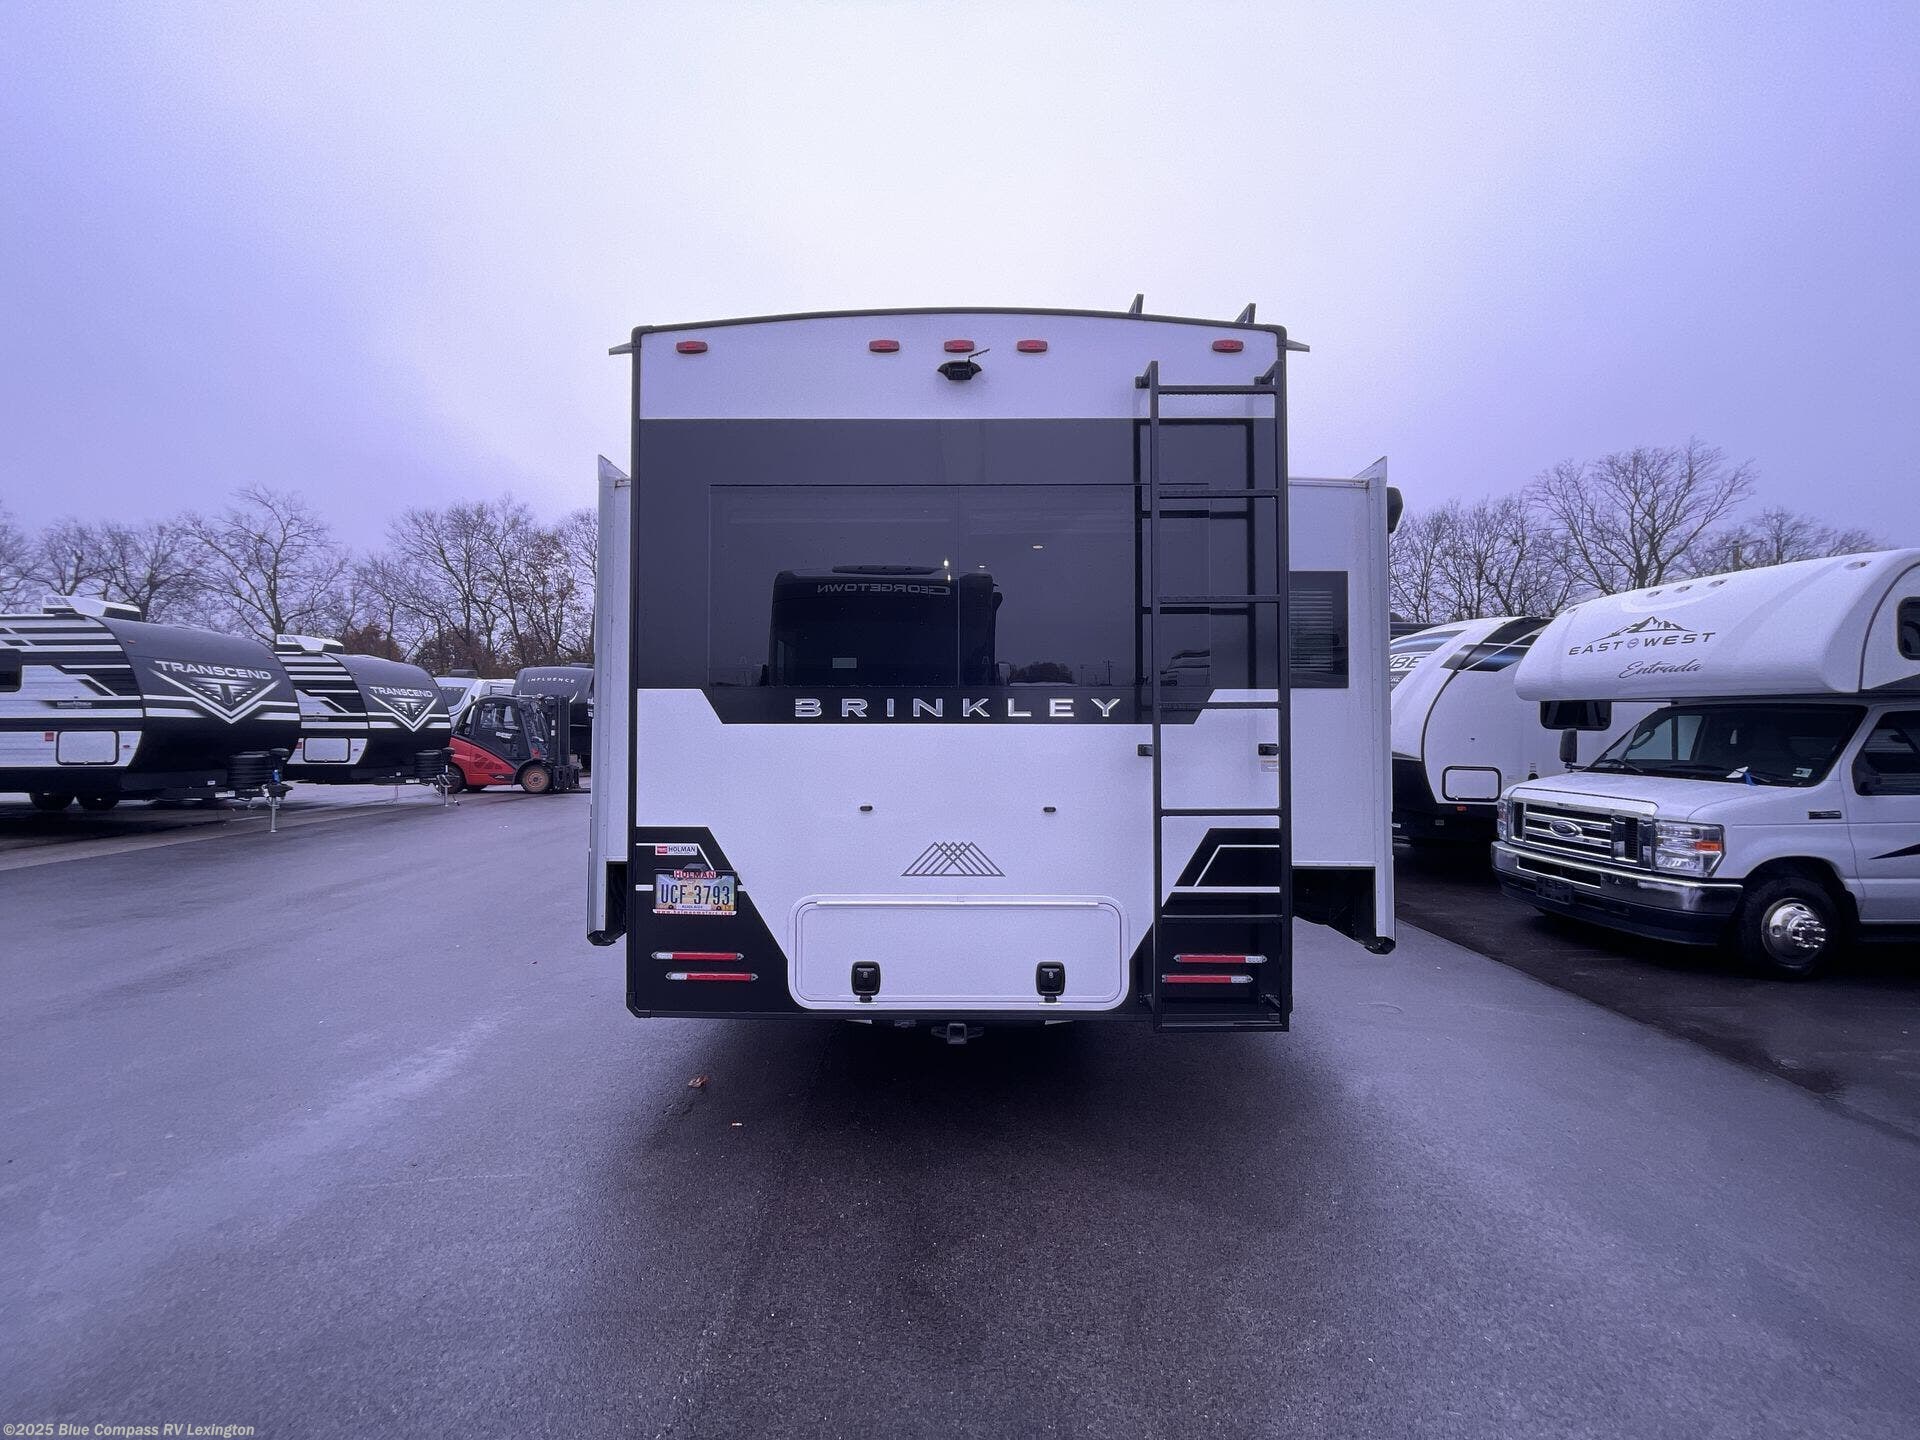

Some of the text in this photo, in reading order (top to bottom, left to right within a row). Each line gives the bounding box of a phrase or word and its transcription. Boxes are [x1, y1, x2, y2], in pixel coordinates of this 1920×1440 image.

[1568, 641, 1624, 656] EAST
[1643, 632, 1716, 647] WEST
[154, 660, 273, 680] TRANSCEND
[1618, 658, 1703, 679] Entrada
[368, 686, 434, 698] TRANSCEND
[794, 697, 1121, 718] BRINKLEY
[675, 870, 715, 878] HOLMAN
[661, 884, 730, 906] UCF 3793
